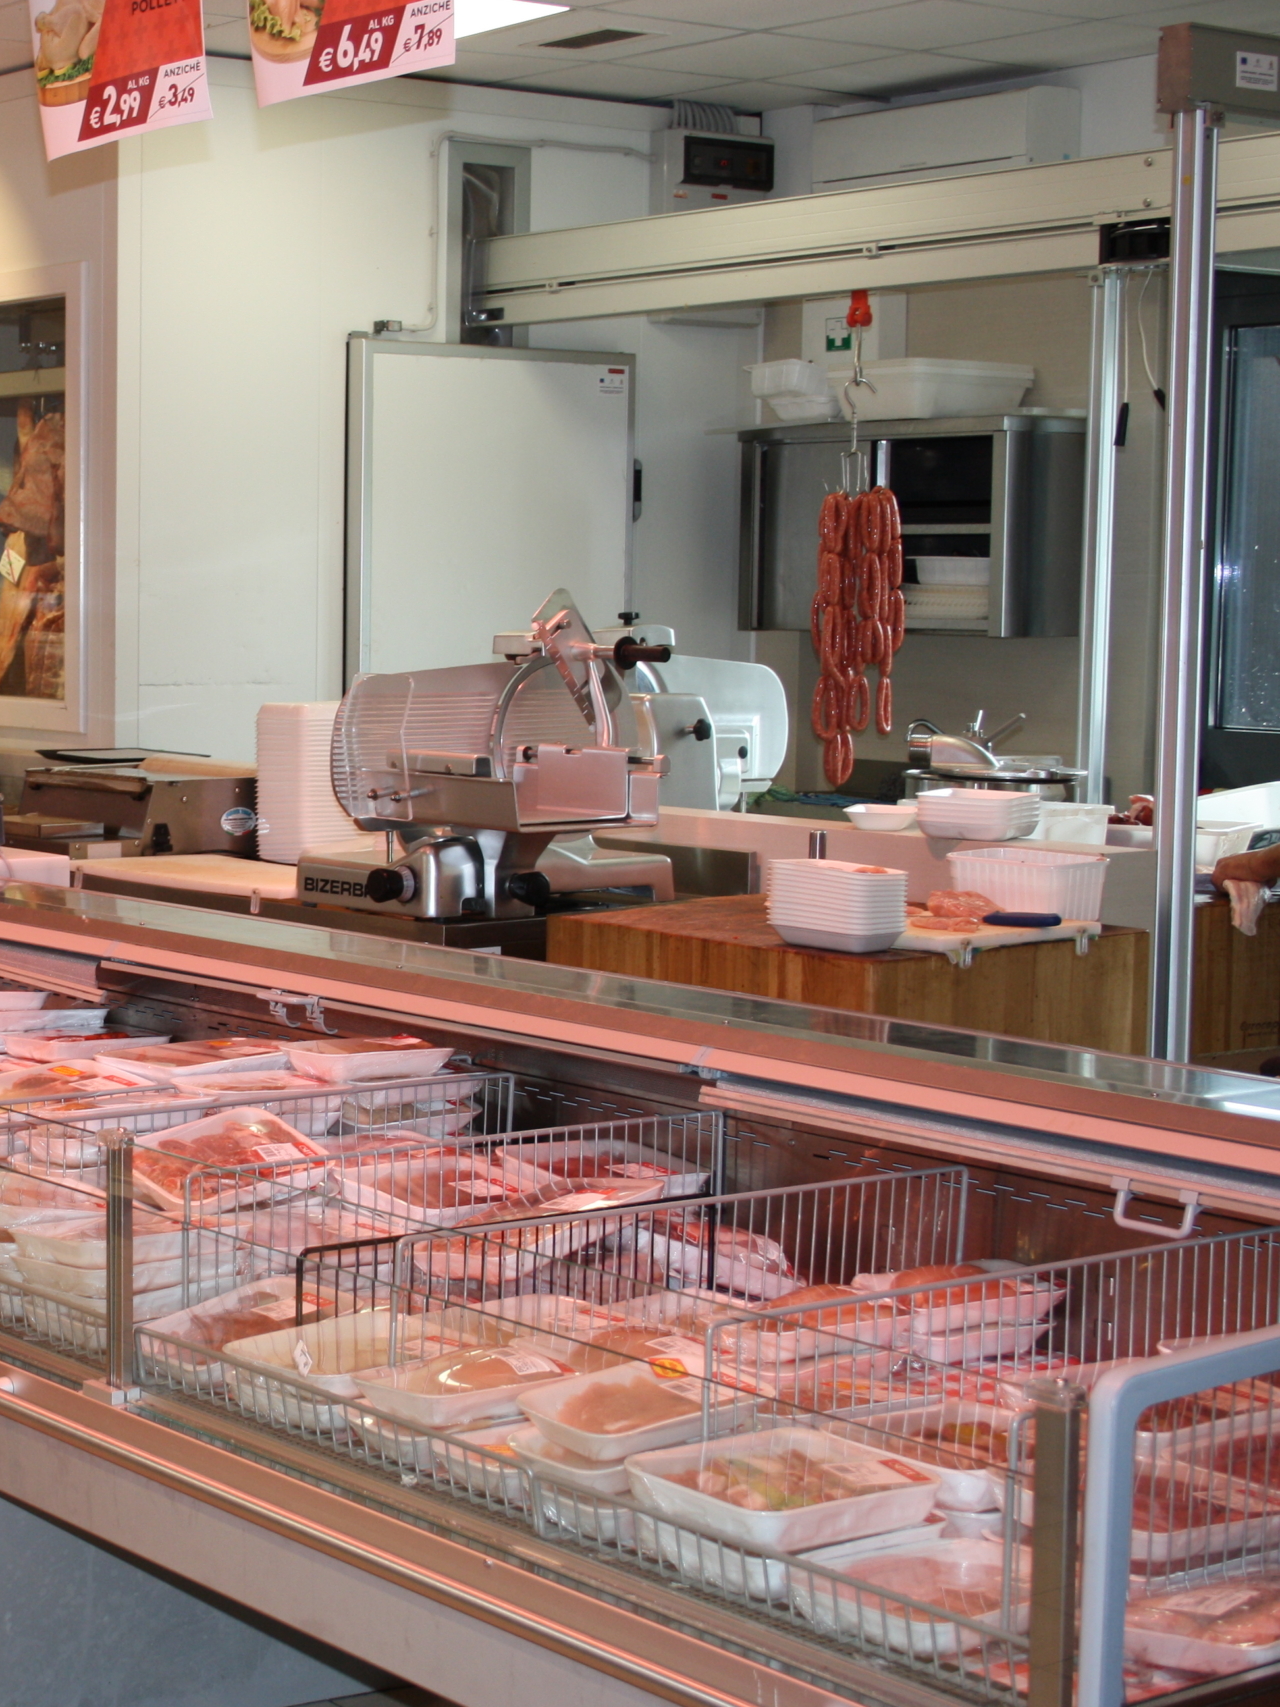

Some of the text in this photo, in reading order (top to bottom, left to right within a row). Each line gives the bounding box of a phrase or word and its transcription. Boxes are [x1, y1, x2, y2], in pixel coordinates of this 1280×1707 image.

[368, 15, 395, 30] AL KG
[127, 75, 150, 90] AL KG
